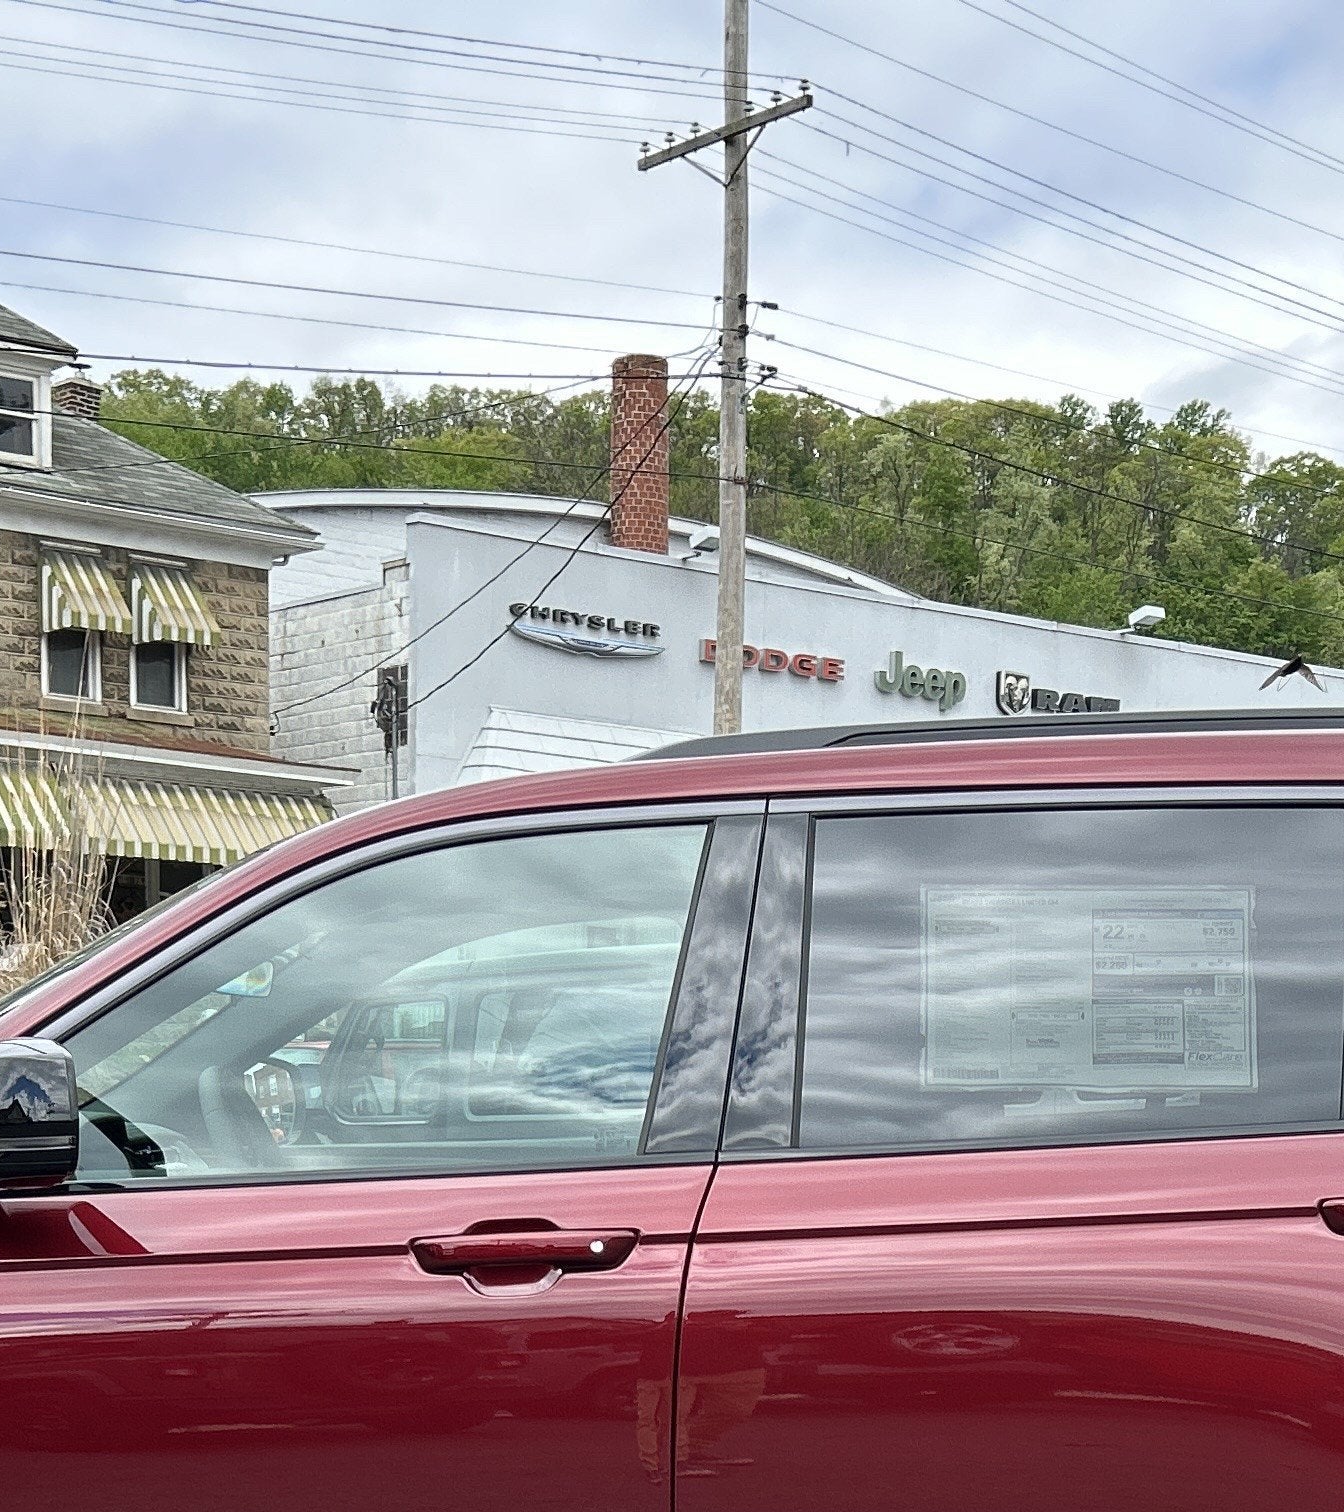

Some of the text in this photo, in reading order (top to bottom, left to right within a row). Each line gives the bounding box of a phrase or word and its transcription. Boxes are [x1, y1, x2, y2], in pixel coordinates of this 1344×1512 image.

[508, 601, 662, 638] CHRYSLER
[874, 650, 967, 713] Jeep
[1031, 687, 1121, 713] RAM
